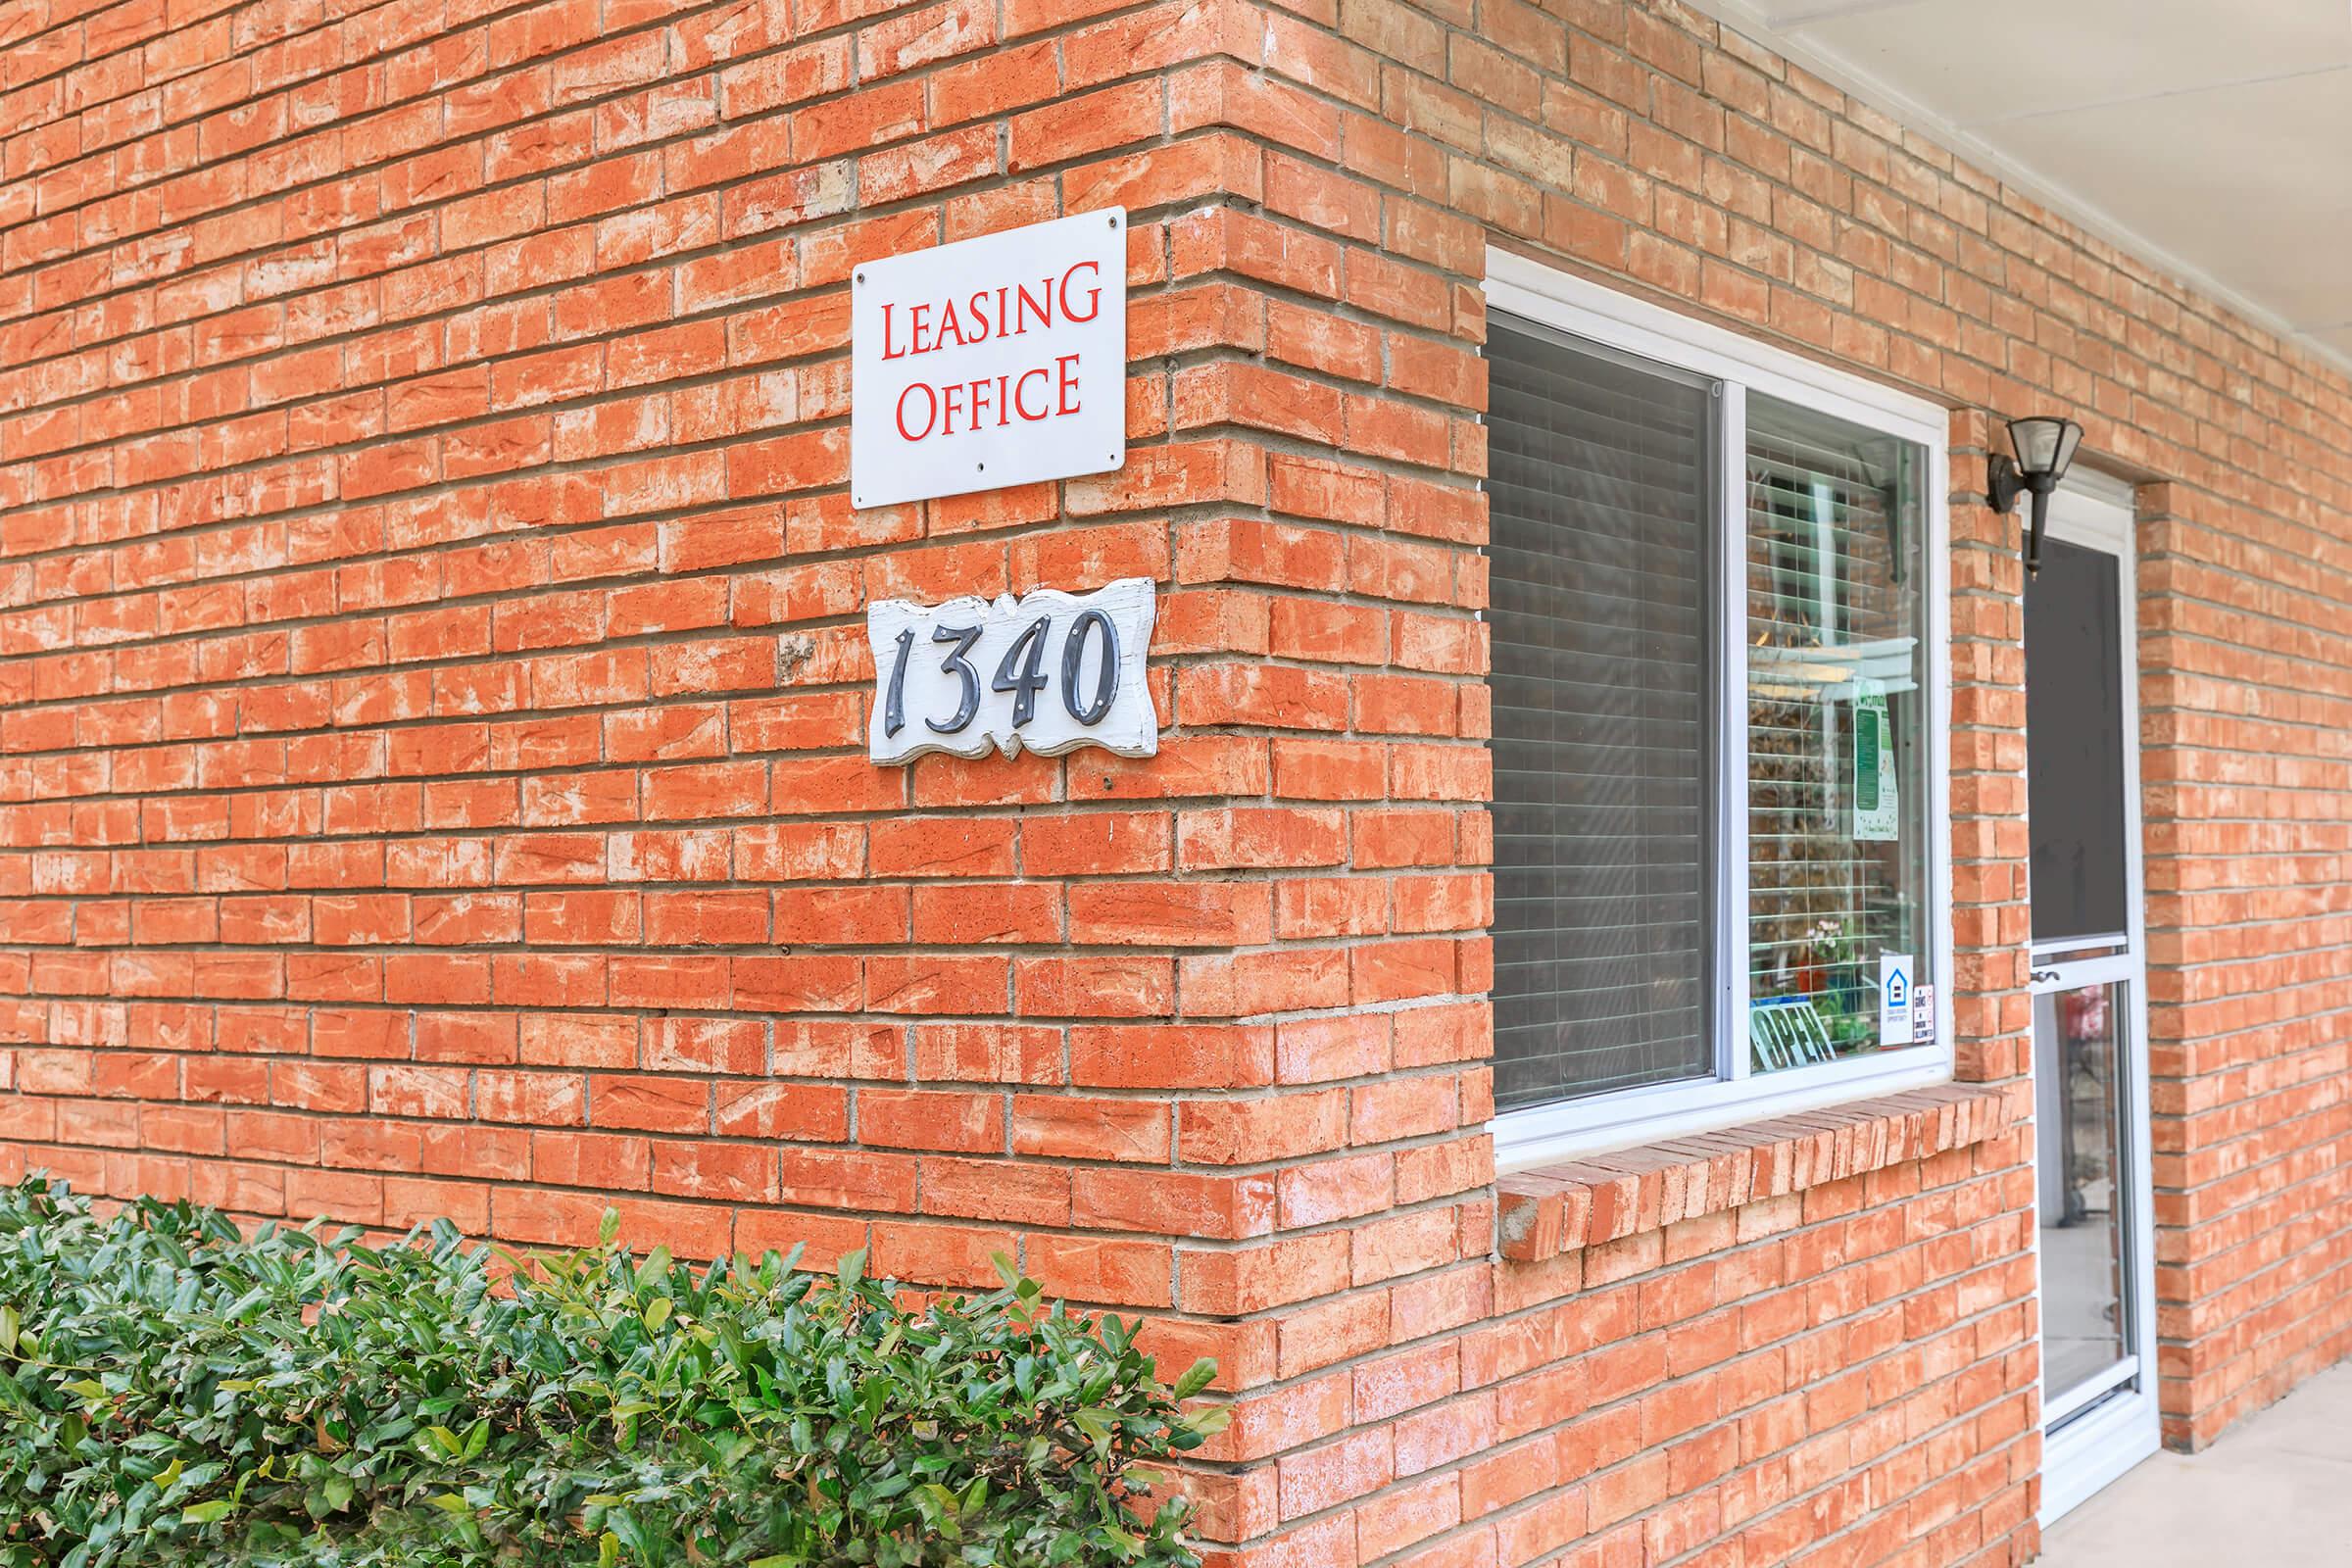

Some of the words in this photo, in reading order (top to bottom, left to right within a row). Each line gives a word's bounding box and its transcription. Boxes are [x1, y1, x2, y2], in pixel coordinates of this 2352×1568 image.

[881, 261, 1102, 361] LEASING
[896, 354, 1081, 442] OFFICE
[885, 609, 1121, 739] 1340
[1752, 1005, 1834, 1069] OPEN
